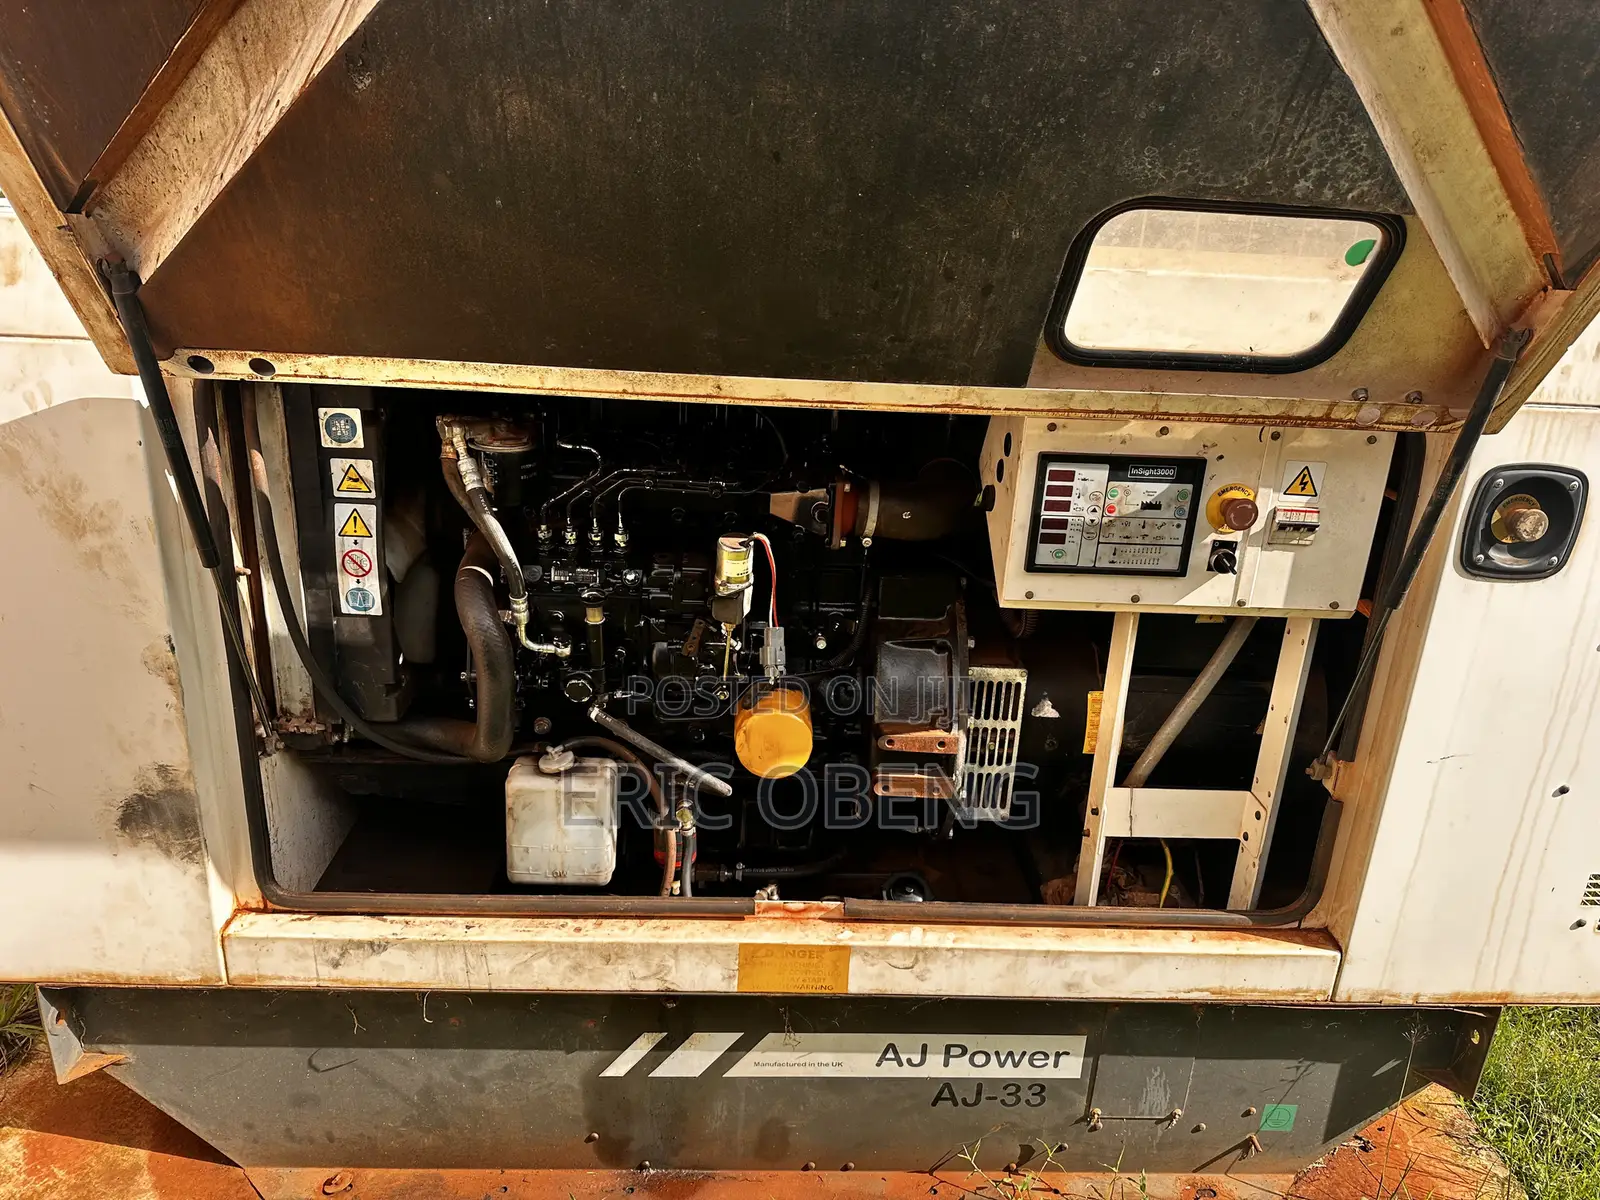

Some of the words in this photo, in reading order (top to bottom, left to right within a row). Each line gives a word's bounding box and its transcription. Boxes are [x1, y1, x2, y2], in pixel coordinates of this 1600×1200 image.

[1131, 467, 1174, 476] InSight3000
[1217, 485, 1252, 497] EMERGENCY
[1502, 496, 1536, 508] EMERGENCY
[544, 869, 570, 878] LOW
[875, 1043, 928, 1068] AJ
[942, 1043, 1070, 1069] Power
[930, 1082, 1047, 1108] AJ-33
